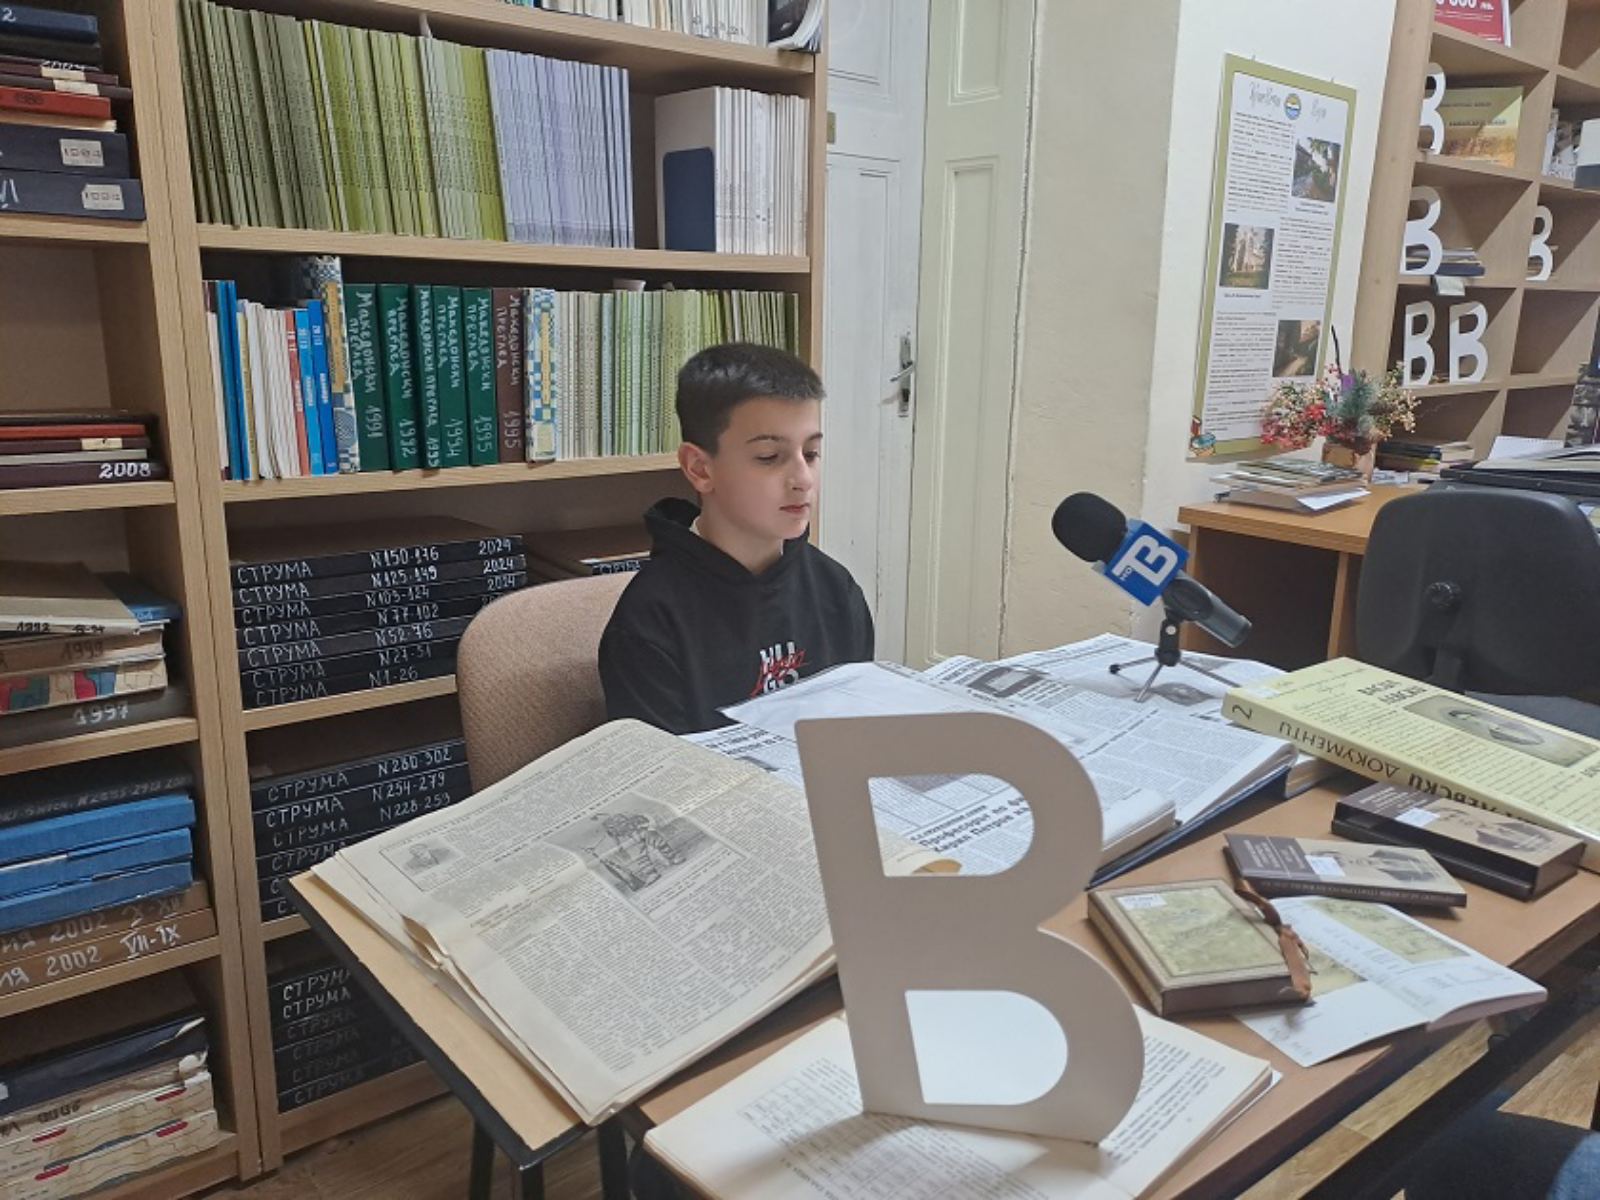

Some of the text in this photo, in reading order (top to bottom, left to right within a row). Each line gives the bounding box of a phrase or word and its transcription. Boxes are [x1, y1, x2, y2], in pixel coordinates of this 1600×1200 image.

[237, 561, 313, 584] СТРУМА
[239, 582, 310, 604] СТРУМА
[242, 601, 312, 624] СТРУМА
[243, 620, 321, 646] СТРУМА
[247, 640, 323, 668] СТРУМА
[252, 661, 326, 688] СТРУМА
[256, 681, 328, 706] СТРУМА
[1231, 703, 1254, 720] 2
[1279, 721, 1401, 779] ДОКУМЕНТИ
[267, 772, 350, 802] СТРУМА
[265, 797, 345, 828] СТРУМА
[273, 818, 350, 847] СТРУМА
[46, 945, 102, 976] 2002
[283, 986, 351, 1019] СТРУМА
